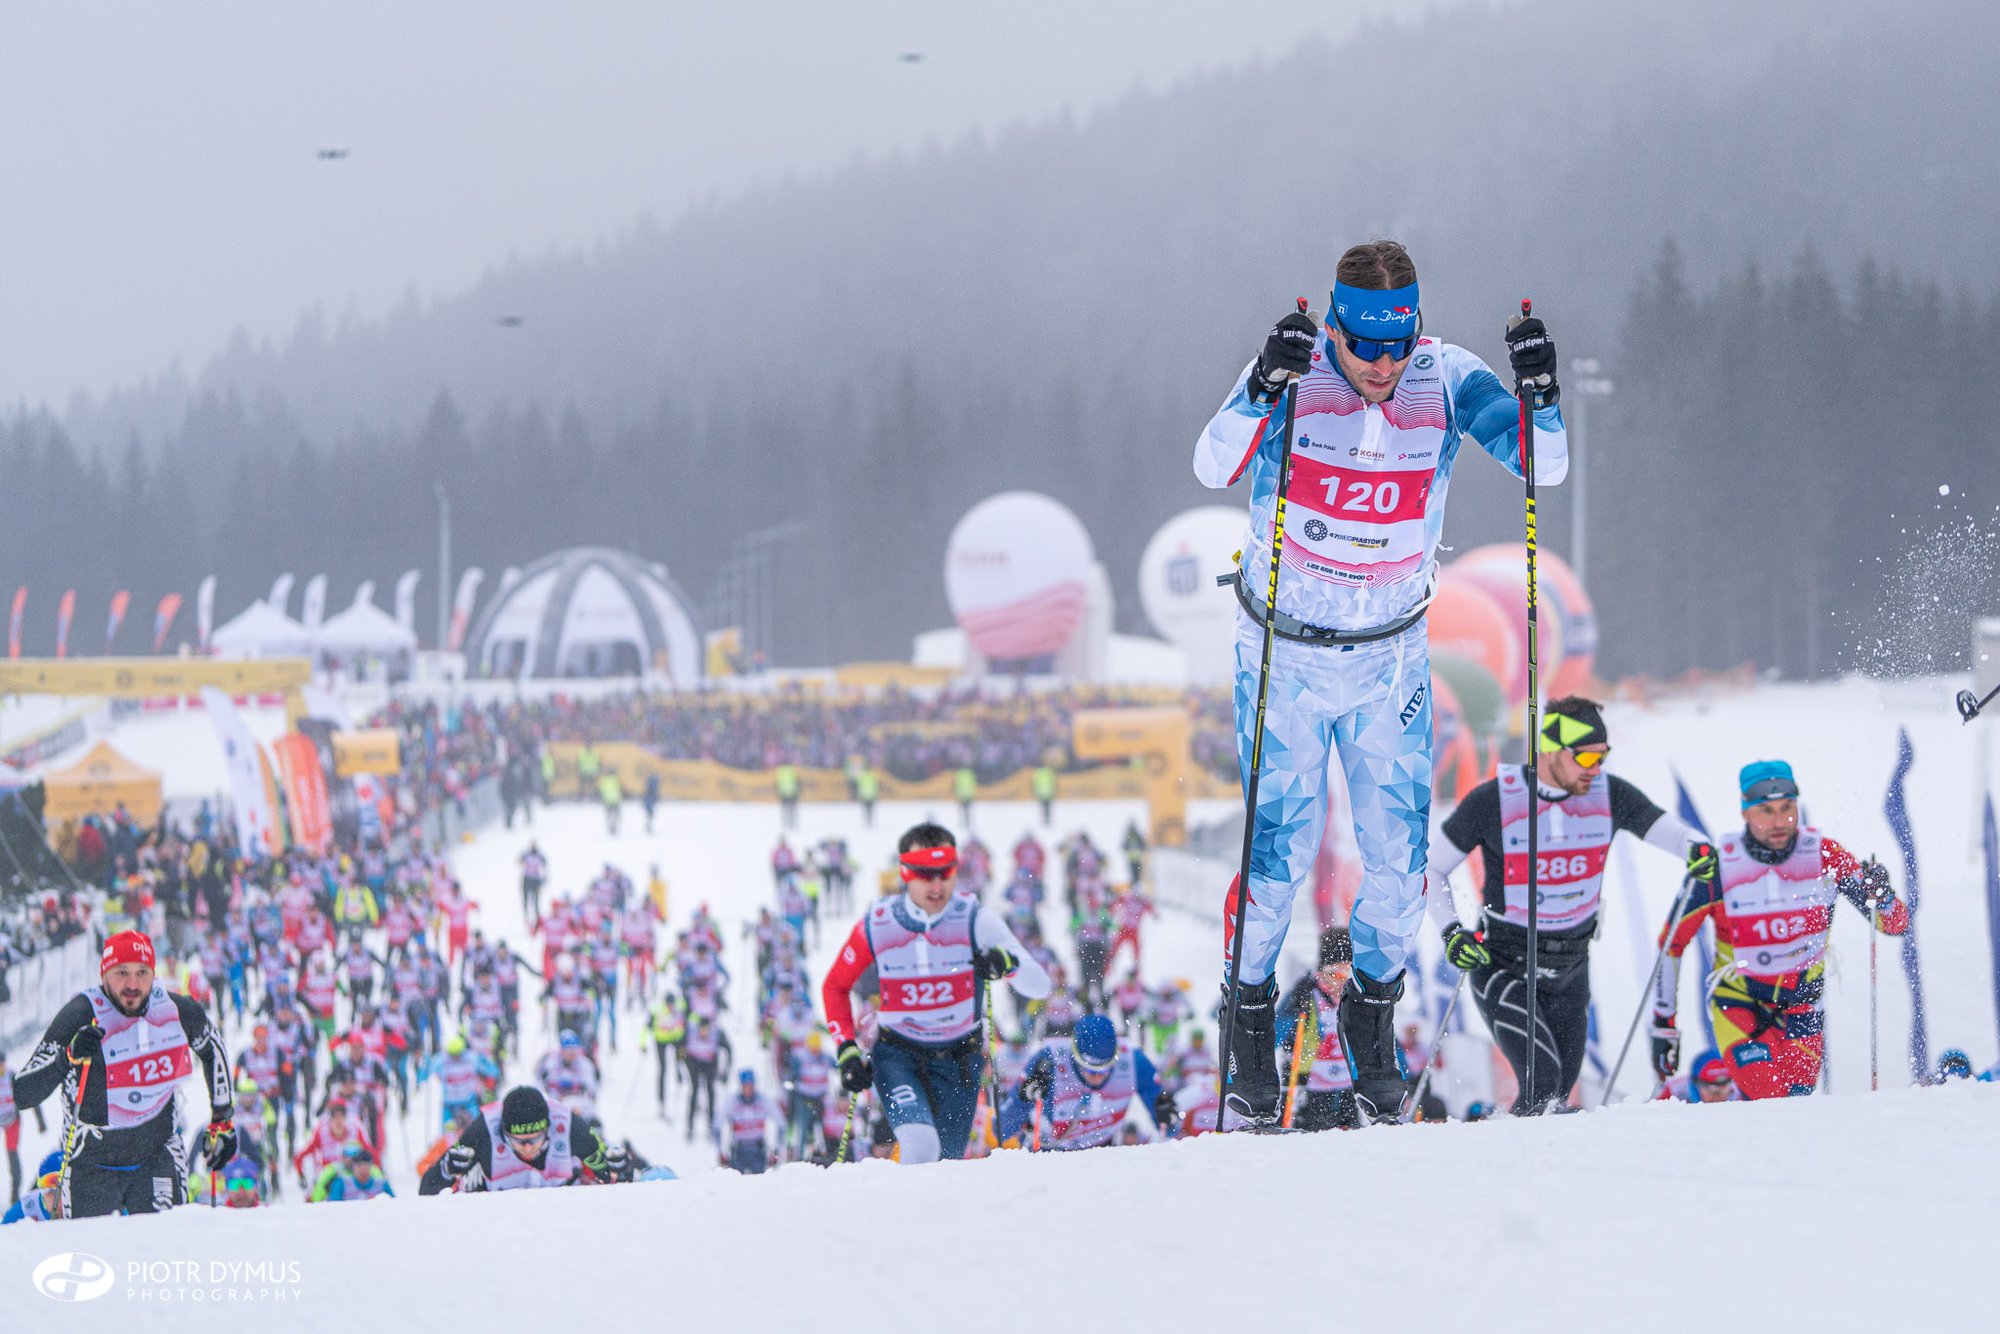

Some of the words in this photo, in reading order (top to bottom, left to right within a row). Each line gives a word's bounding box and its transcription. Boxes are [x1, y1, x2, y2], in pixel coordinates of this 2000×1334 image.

[1311, 441, 1323, 449] Bank
[1323, 443, 1337, 452] Polski
[1360, 449, 1385, 459] KGHM
[1408, 451, 1433, 460] TAURON
[1320, 475, 1400, 514] 120
[1274, 496, 1287, 550] LEKI
[1526, 498, 1536, 550] LEKI
[1400, 682, 1425, 727] ATEX
[1537, 855, 1587, 881] 286
[1752, 916, 1806, 941] 102
[901, 981, 955, 1007] 322
[128, 1055, 174, 1083] 123
